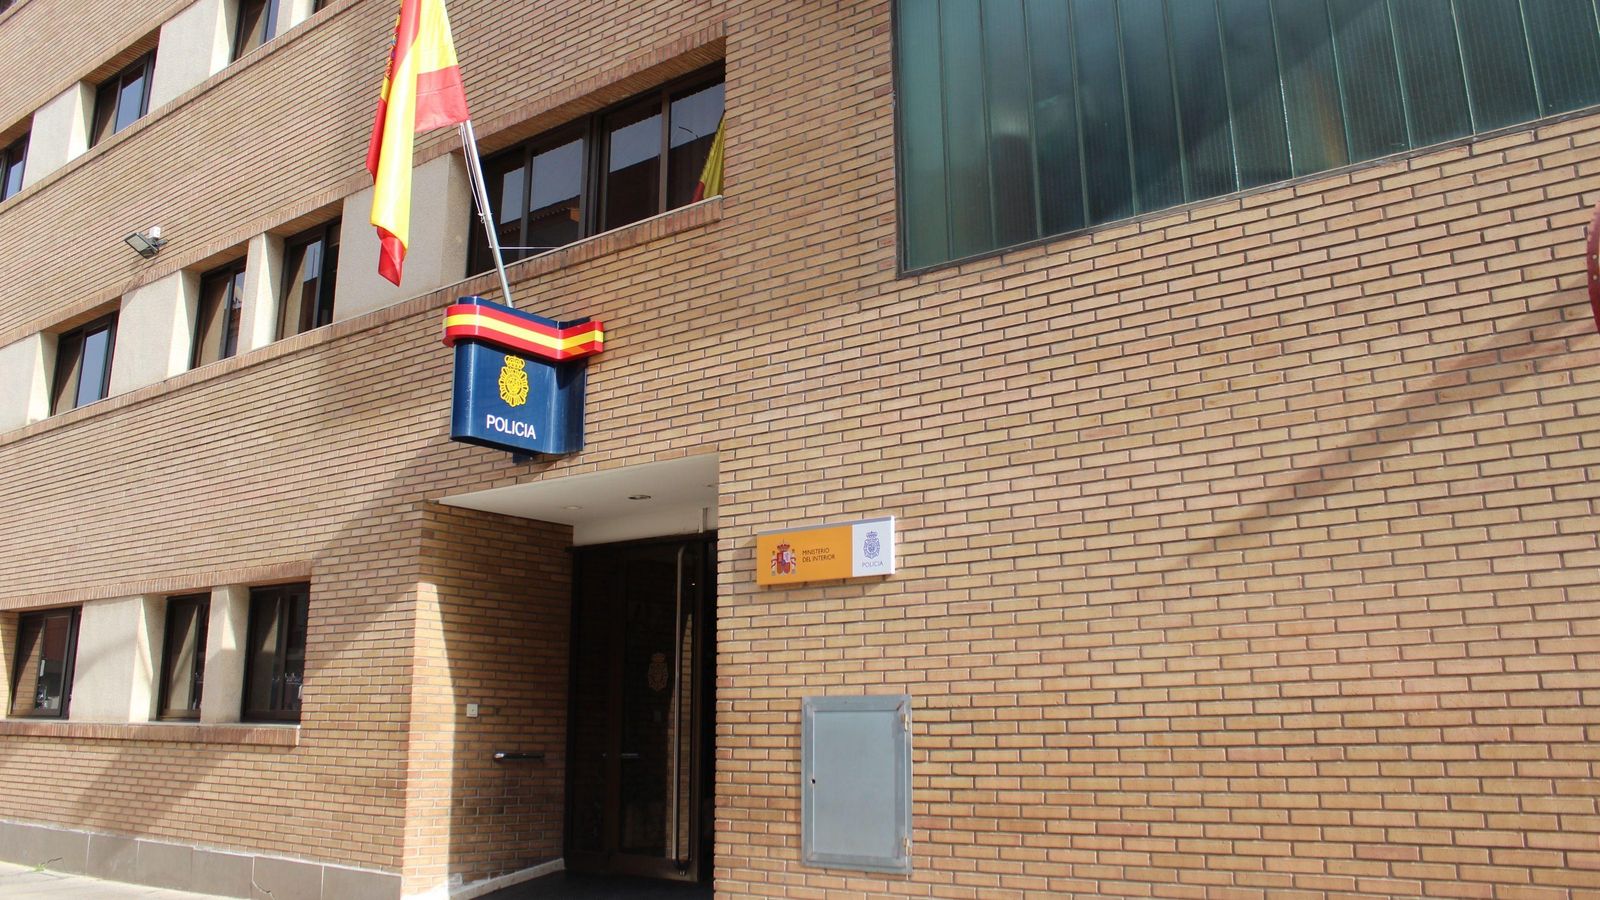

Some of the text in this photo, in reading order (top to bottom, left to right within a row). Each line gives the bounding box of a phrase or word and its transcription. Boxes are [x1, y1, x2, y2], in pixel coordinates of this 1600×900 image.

[486, 414, 537, 440] POLICIA
[802, 547, 830, 556] MINISTERIO
[813, 553, 835, 562] INTERIOR
[862, 560, 884, 568] POLICIA
